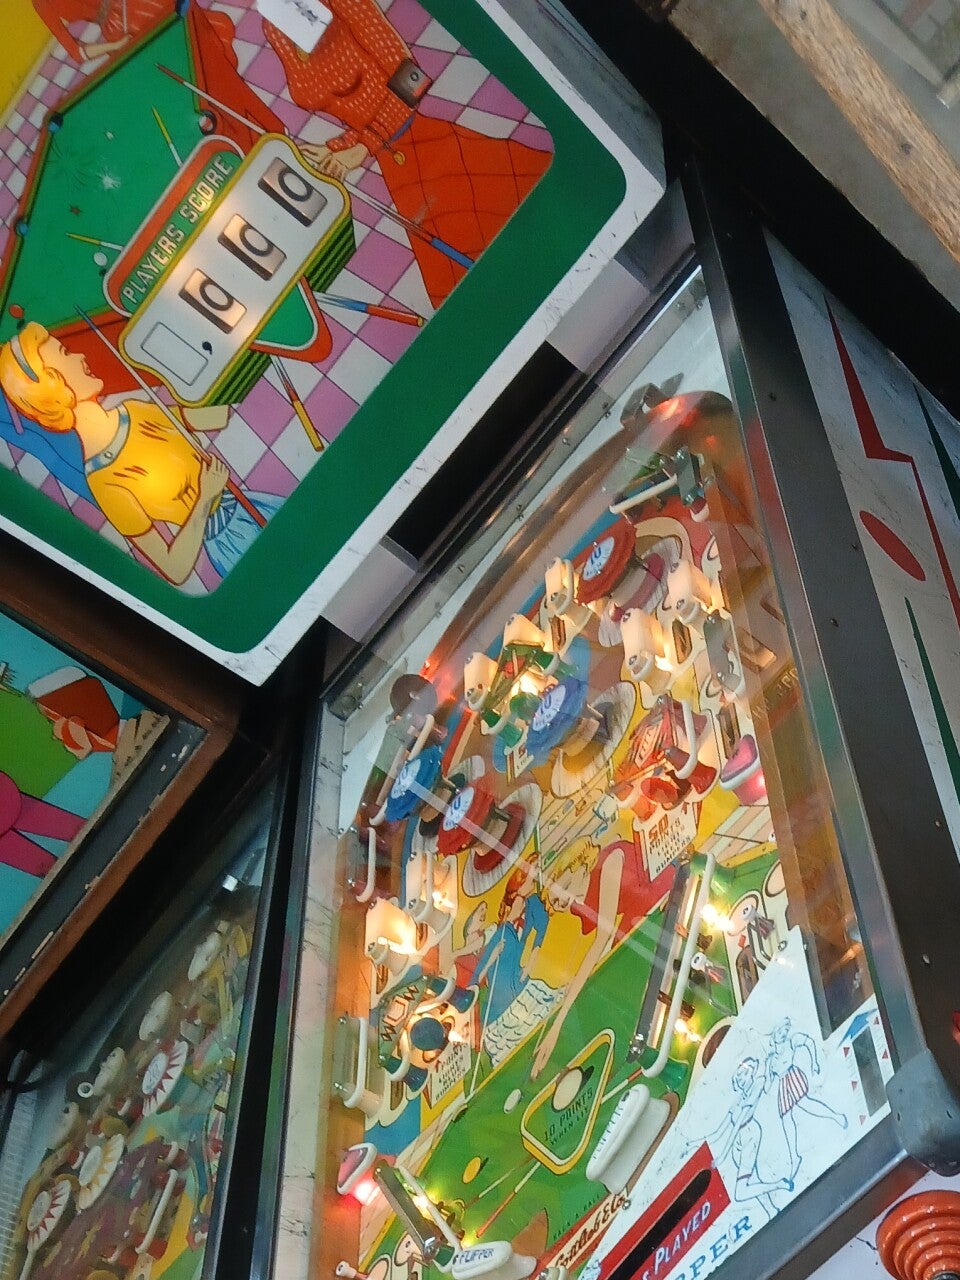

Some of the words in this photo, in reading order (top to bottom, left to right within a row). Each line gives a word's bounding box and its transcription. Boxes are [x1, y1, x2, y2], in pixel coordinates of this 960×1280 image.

[122, 223, 185, 305] PLAYERS
[179, 155, 234, 224] SCORE
[545, 1123, 555, 1141] 10
[560, 1088, 593, 1126] POINTS
[551, 1121, 573, 1145] WHEN
[459, 1248, 494, 1264] FLIPPER
[654, 1200, 712, 1275] PLAYED
